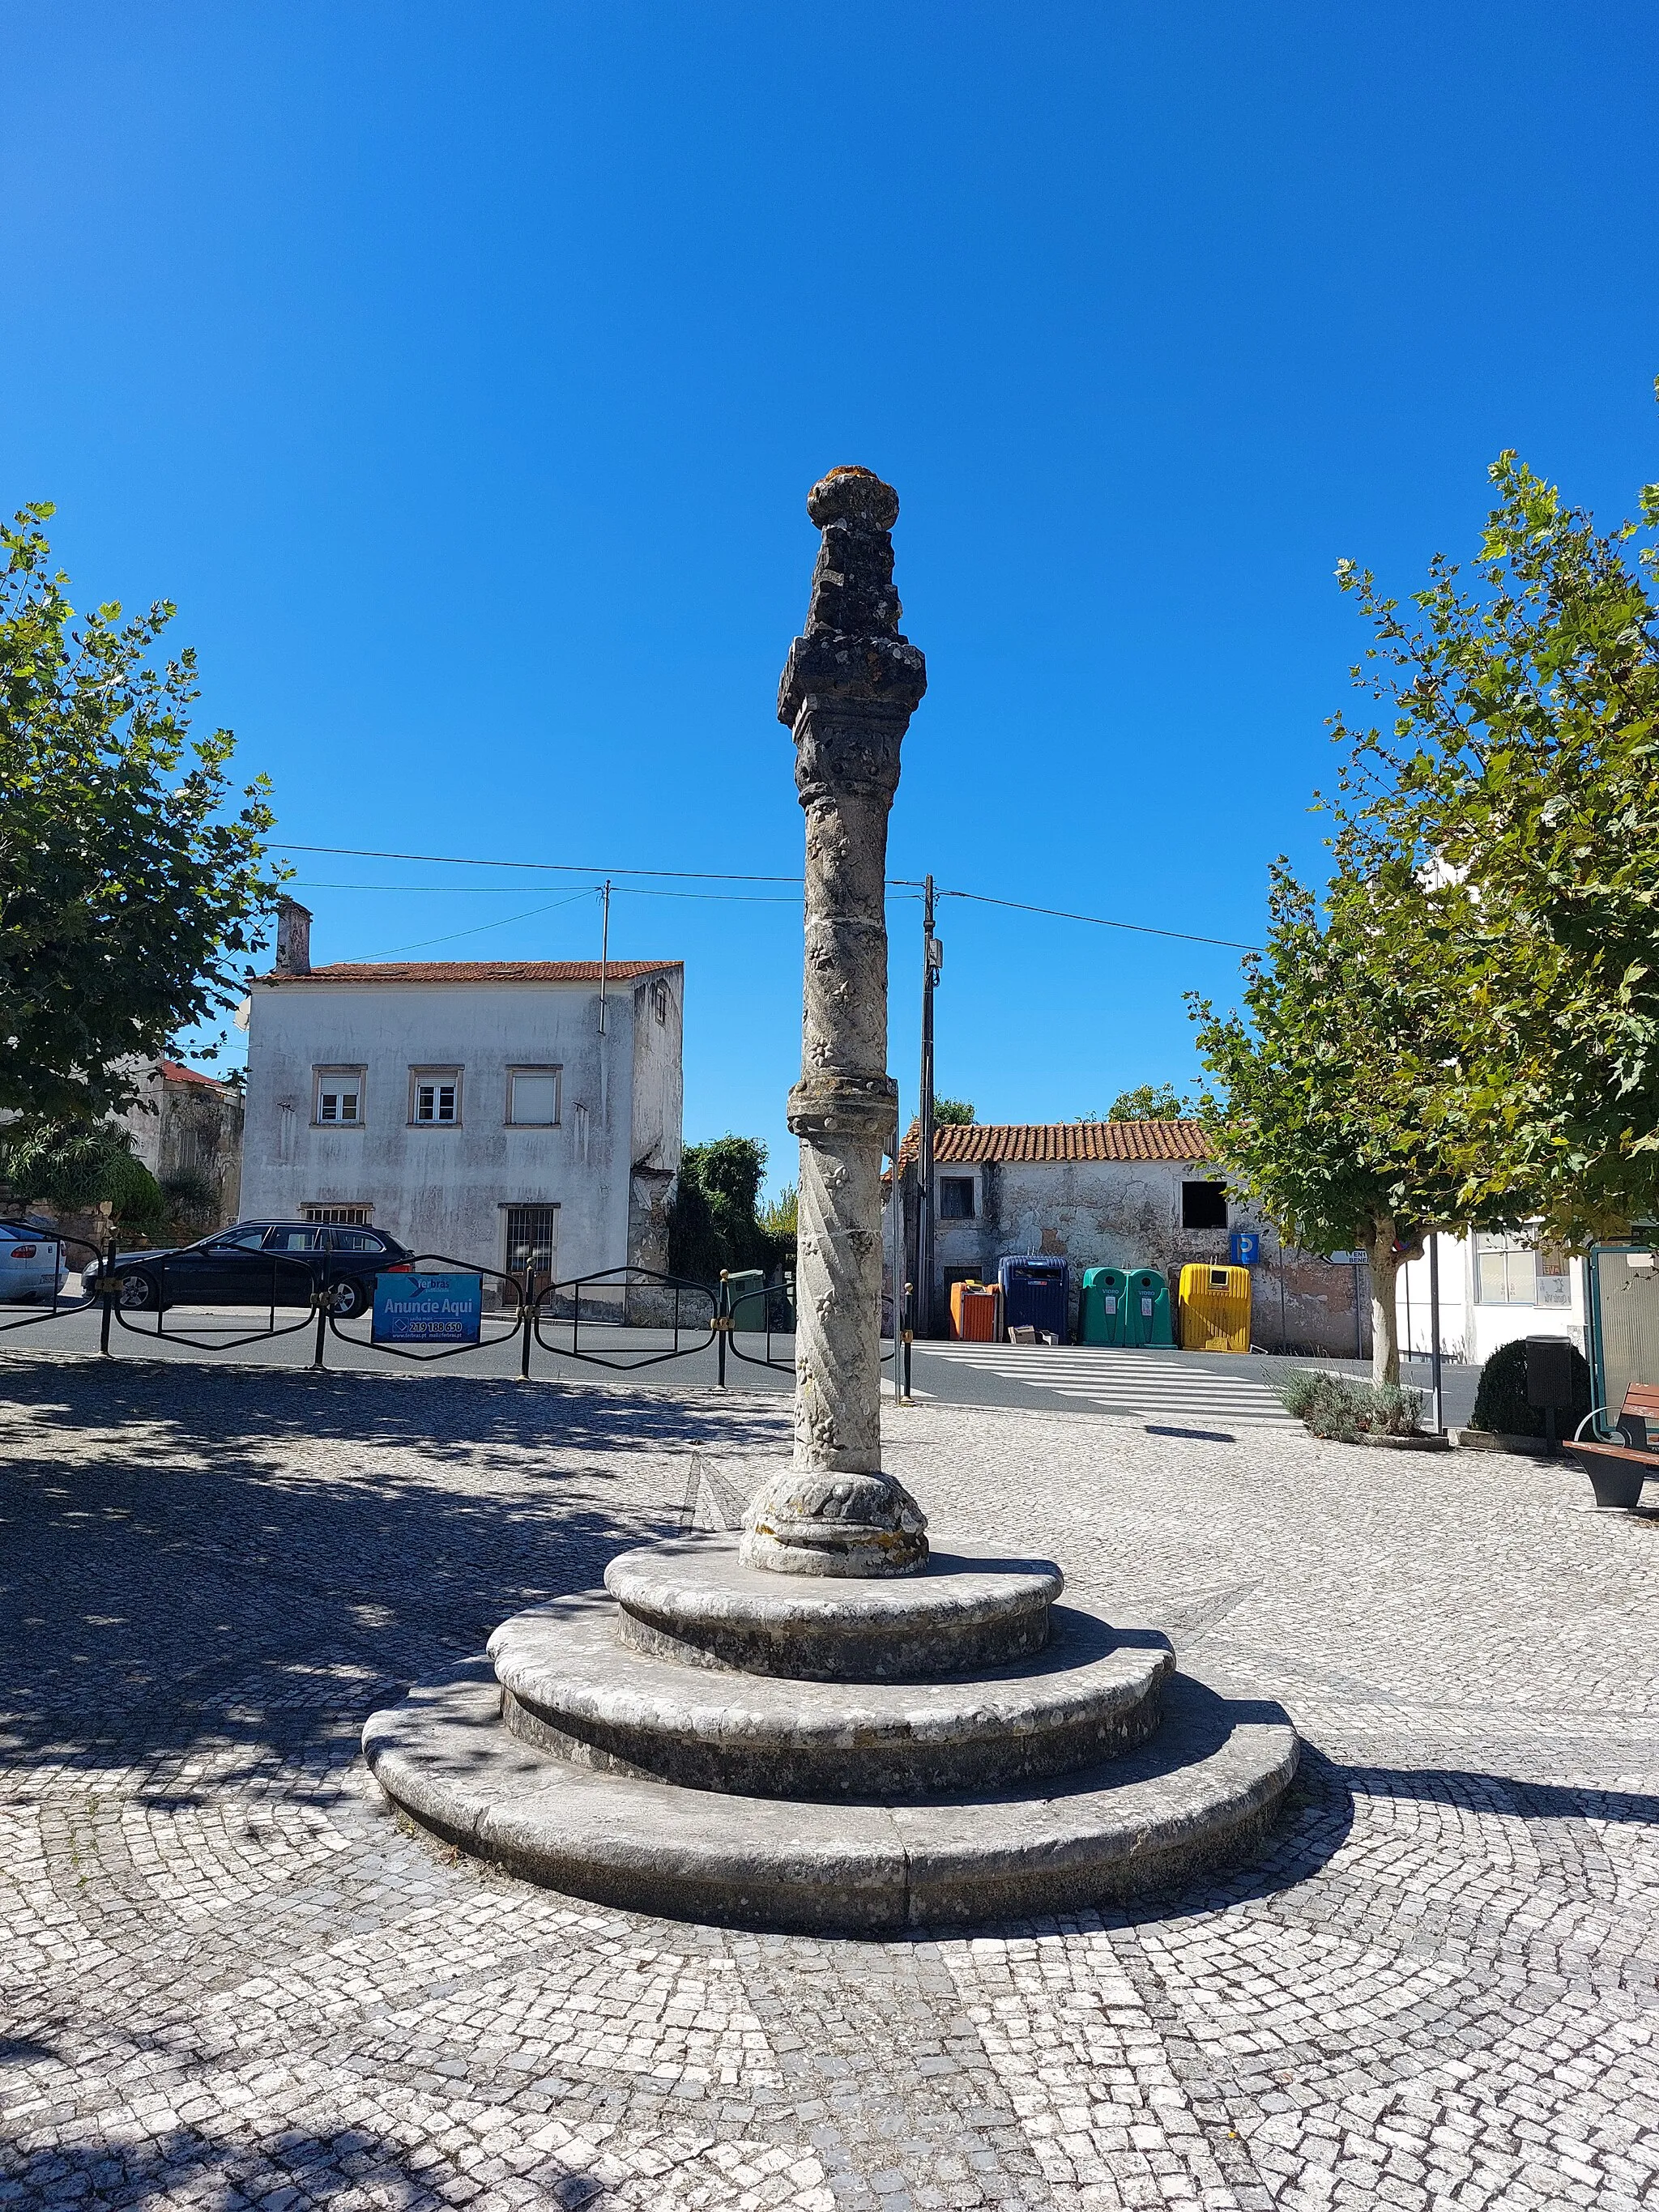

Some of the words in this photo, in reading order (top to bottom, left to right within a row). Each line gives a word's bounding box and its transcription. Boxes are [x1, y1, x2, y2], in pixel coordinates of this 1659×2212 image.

[1237, 1237, 1253, 1260] P
[417, 1279, 450, 1289] ferbras
[384, 1298, 440, 1313] Anuncie
[441, 1298, 472, 1317] Aqui
[409, 1322, 427, 1332] 219
[428, 1322, 445, 1332] 188
[445, 1322, 463, 1332] 650
